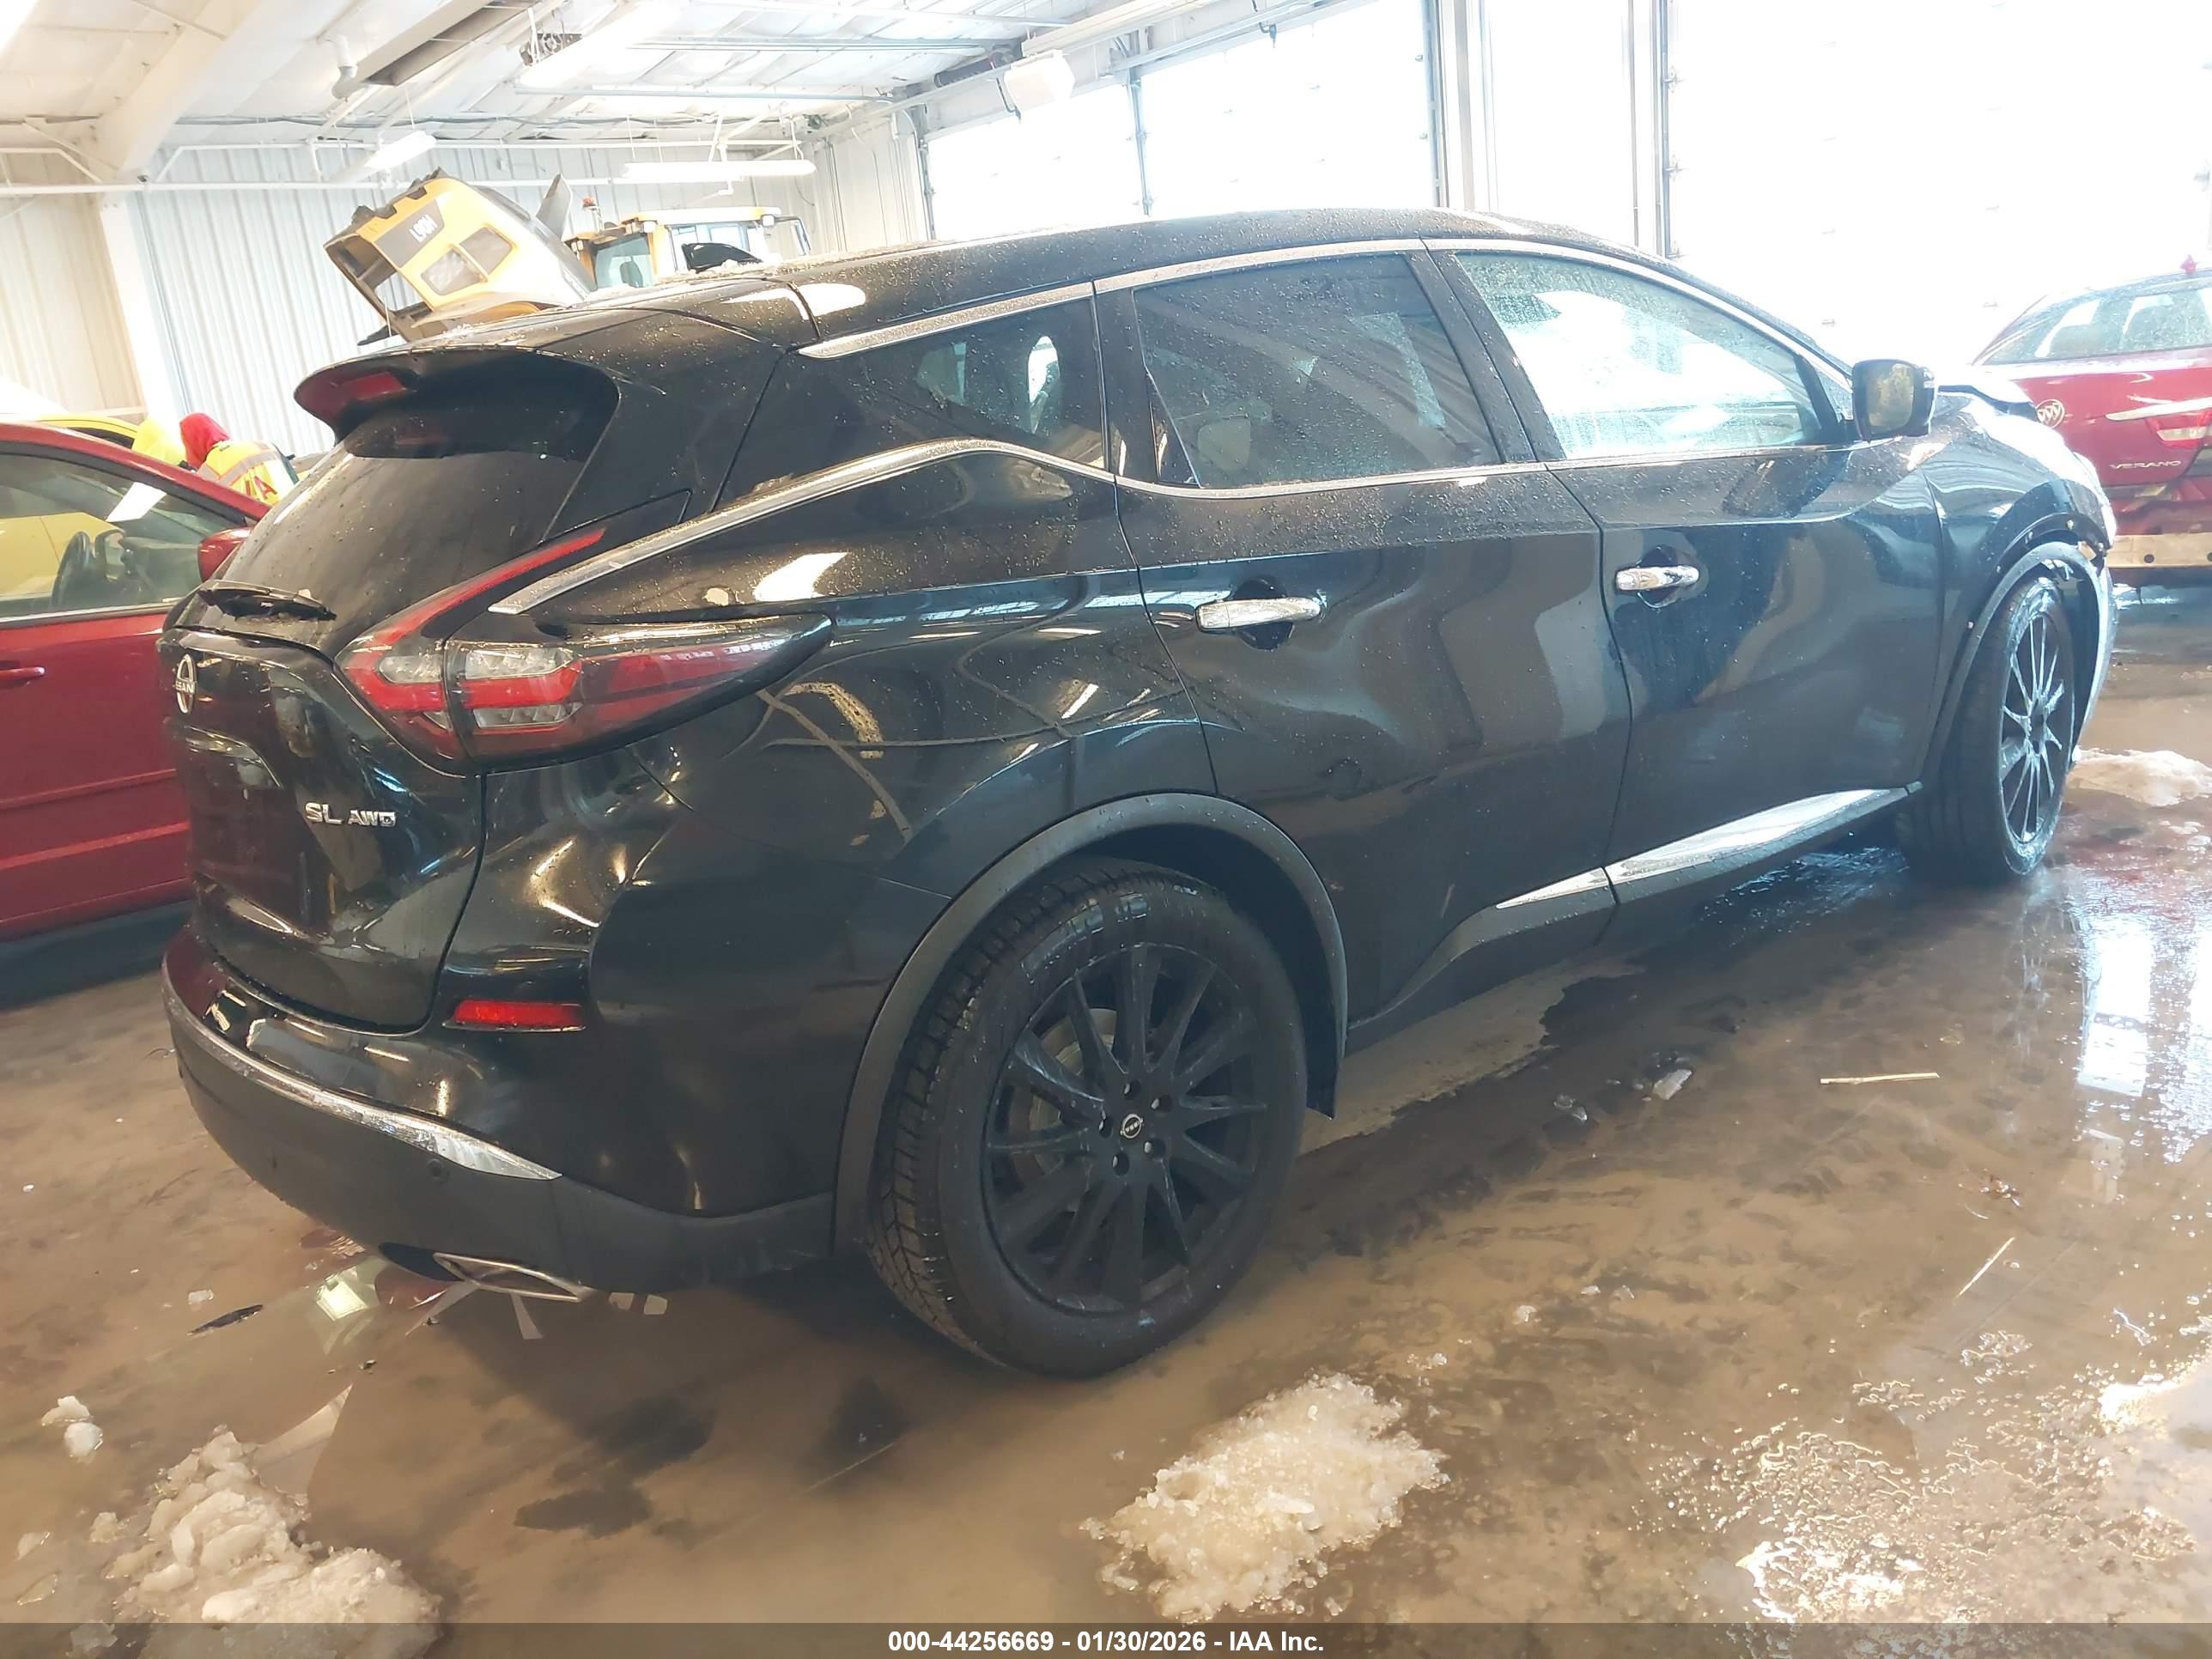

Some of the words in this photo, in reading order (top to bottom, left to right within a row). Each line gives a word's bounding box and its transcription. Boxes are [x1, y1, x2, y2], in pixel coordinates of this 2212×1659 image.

[2109, 460, 2182, 469] VERANO
[306, 802, 343, 824] SL
[348, 810, 396, 827] AWD
